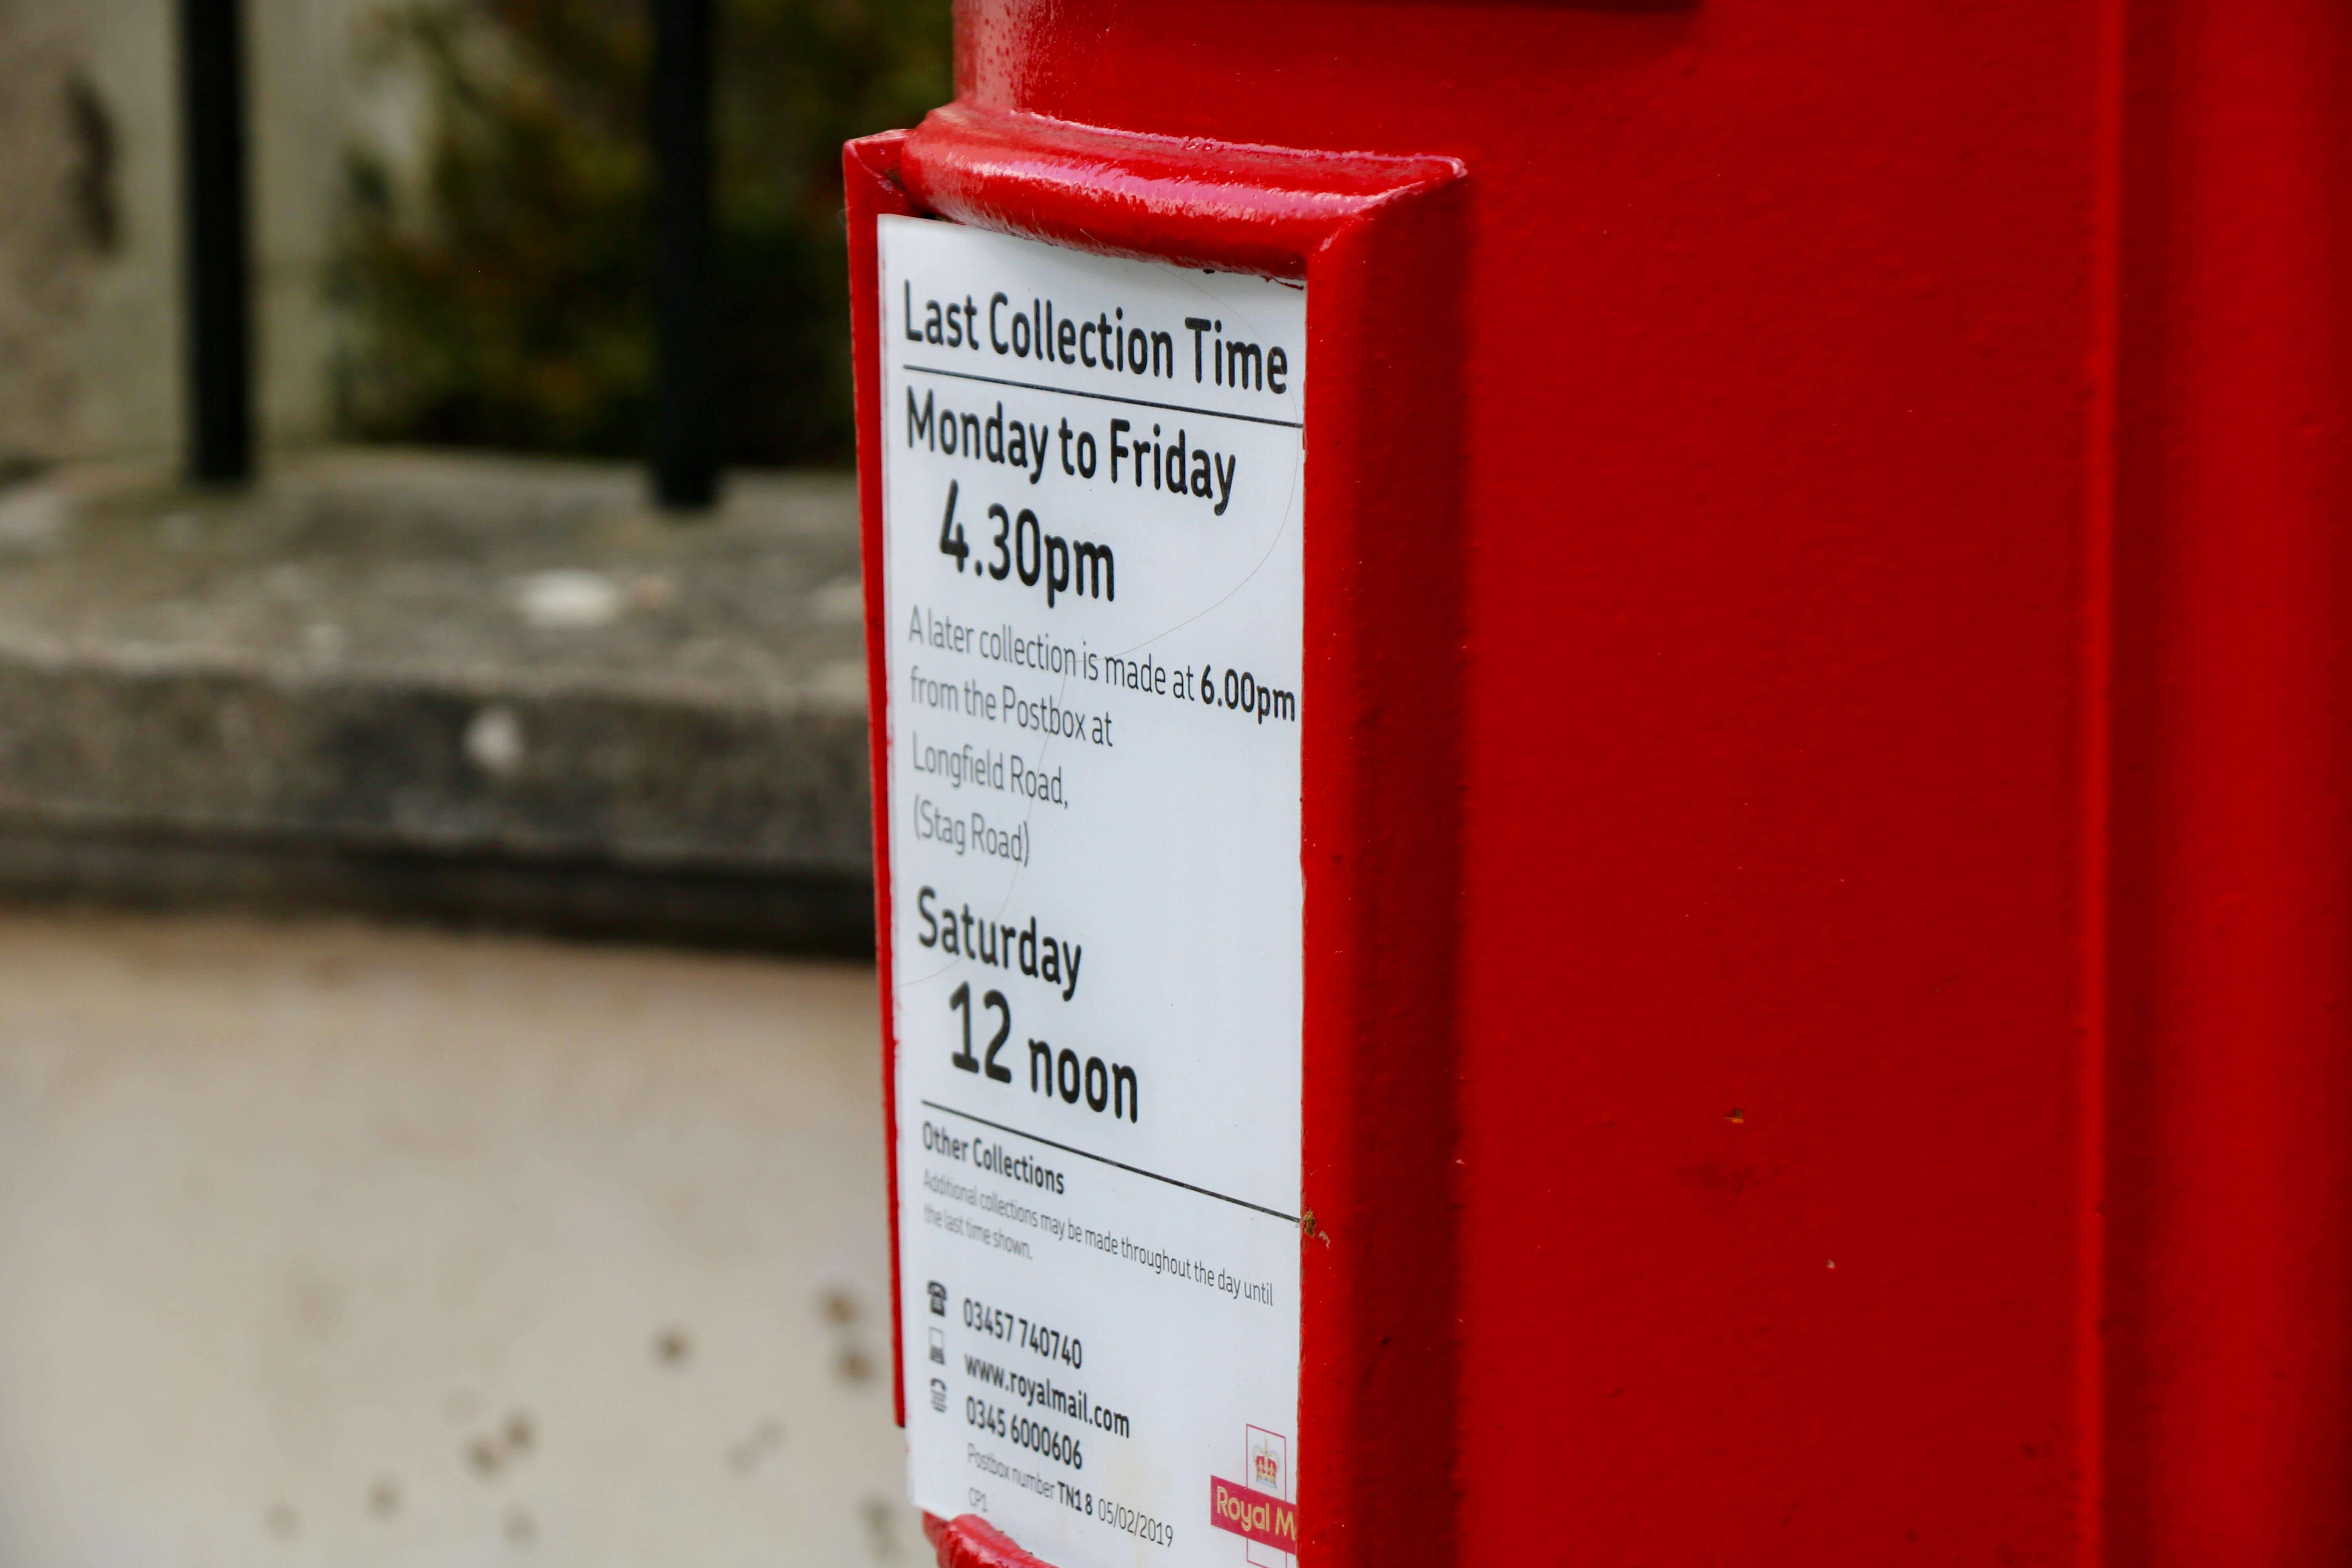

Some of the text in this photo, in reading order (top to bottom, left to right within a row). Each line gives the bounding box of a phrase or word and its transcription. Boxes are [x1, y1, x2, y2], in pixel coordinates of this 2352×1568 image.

[903, 279, 1288, 394] Last Collection Time
[906, 385, 1236, 516] Monday to Friday
[939, 479, 1114, 608] 4.30pm
[909, 604, 1295, 724] A later collection is made at 6.00pm
[910, 665, 1113, 747] from the Postbox at
[912, 731, 1068, 809] Longfield Road,
[914, 793, 1029, 867] (Stag Road)
[917, 885, 1082, 1002] Saturday
[949, 979, 1138, 1124] 12 noon
[922, 1121, 1065, 1195] Other Collections
[923, 1169, 1274, 1307] Additional collections may be made throughout the day until
[924, 1203, 1033, 1259] the last time shown.
[963, 1298, 1082, 1369] 03457 740740
[964, 1353, 1130, 1438] www.royalmail.com
[966, 1396, 1083, 1470] 0345 6000606
[967, 1443, 1010, 1481] Postbox
[1013, 1468, 1056, 1499] number
[1098, 1497, 1173, 1547] 05/02/2019
[1216, 1485, 1270, 1532] Royal
